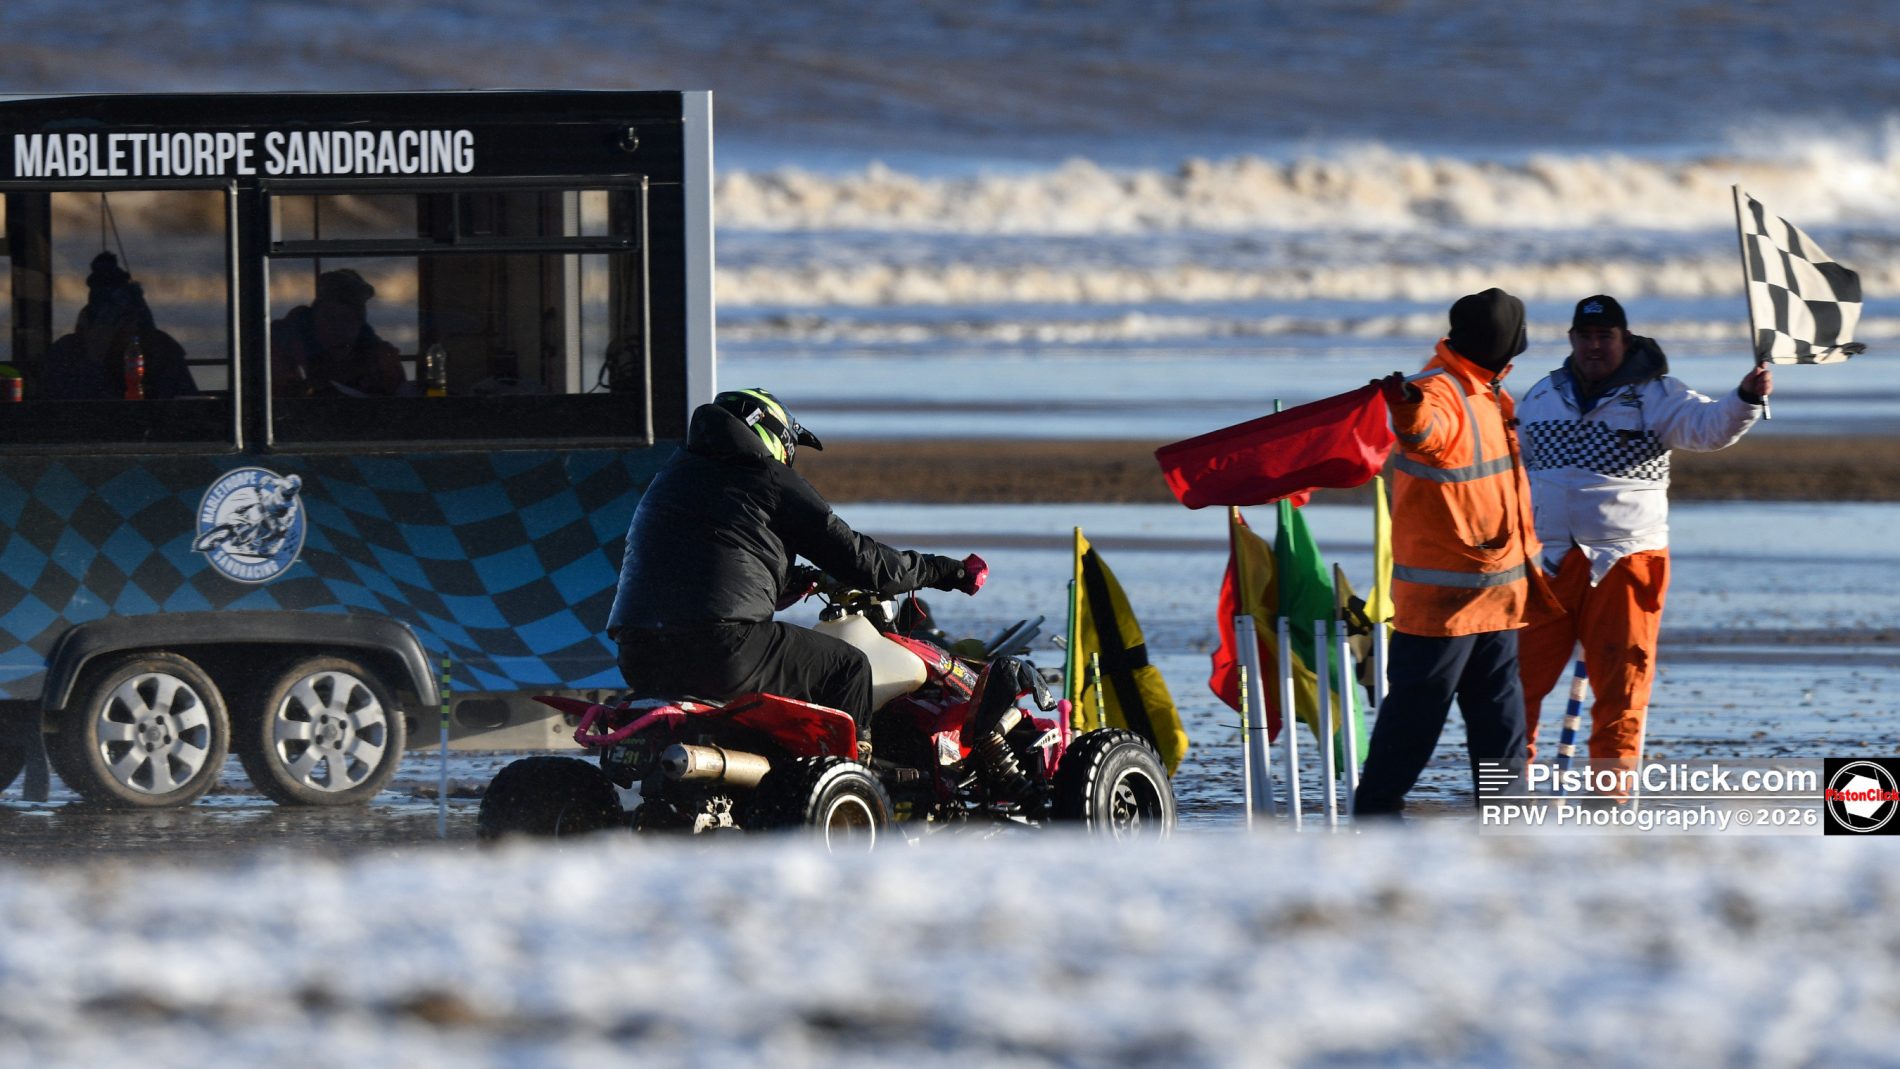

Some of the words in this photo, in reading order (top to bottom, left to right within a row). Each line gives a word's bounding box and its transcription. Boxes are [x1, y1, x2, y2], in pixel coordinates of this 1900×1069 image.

[14, 132, 257, 177] MABLETHORPE
[264, 129, 475, 174] SANDRACING
[201, 470, 257, 523] MABLETHORPE
[212, 549, 280, 580] SANDRACING
